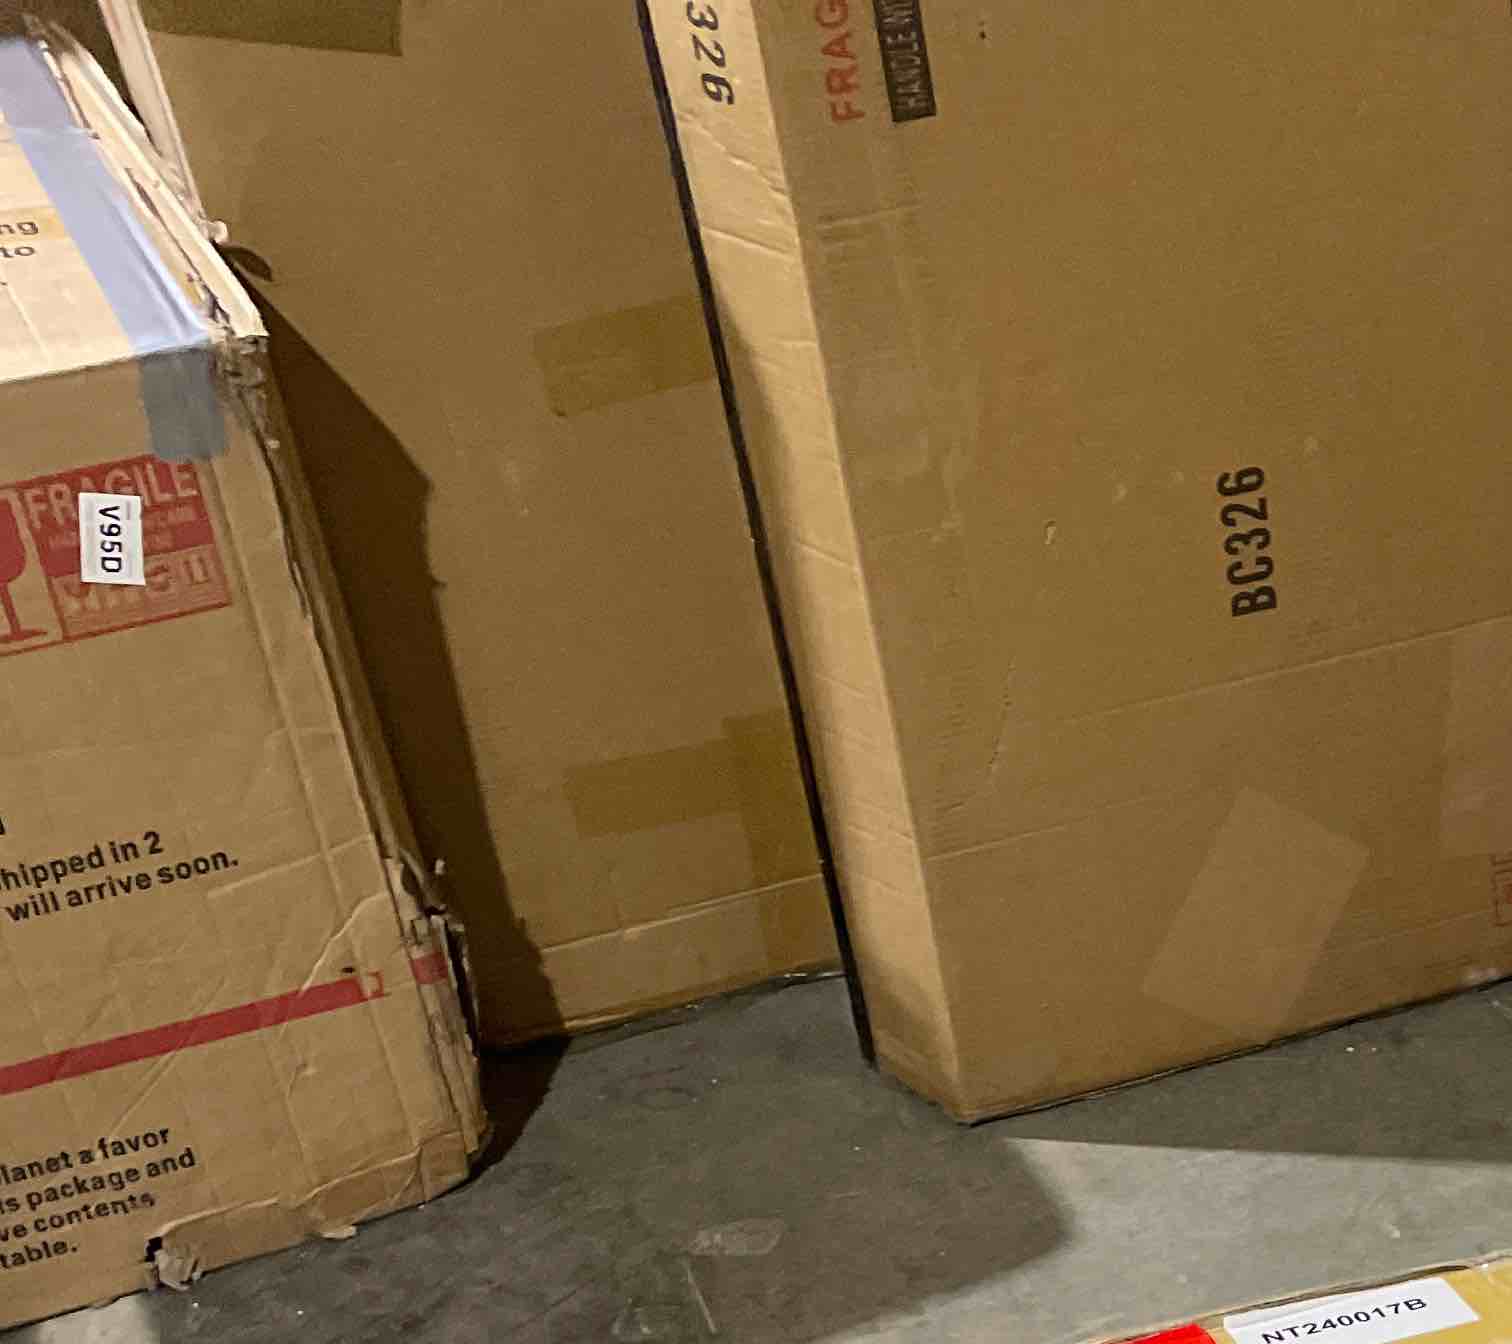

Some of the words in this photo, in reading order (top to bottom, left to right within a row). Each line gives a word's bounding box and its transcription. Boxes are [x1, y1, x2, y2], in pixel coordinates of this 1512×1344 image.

[98, 505, 123, 573] V95D
[1216, 466, 1278, 617] BC326
[109, 839, 140, 864] in
[143, 830, 164, 855] 2
[5, 890, 61, 921] will
[65, 871, 152, 908] arrive
[157, 850, 239, 884] soon.
[79, 1148, 95, 1165] a
[98, 1127, 169, 1160] favor
[26, 1167, 140, 1211] package
[146, 1146, 196, 1178] and
[34, 1191, 156, 1233] contents
[1261, 1298, 1428, 1344] NT240017B
